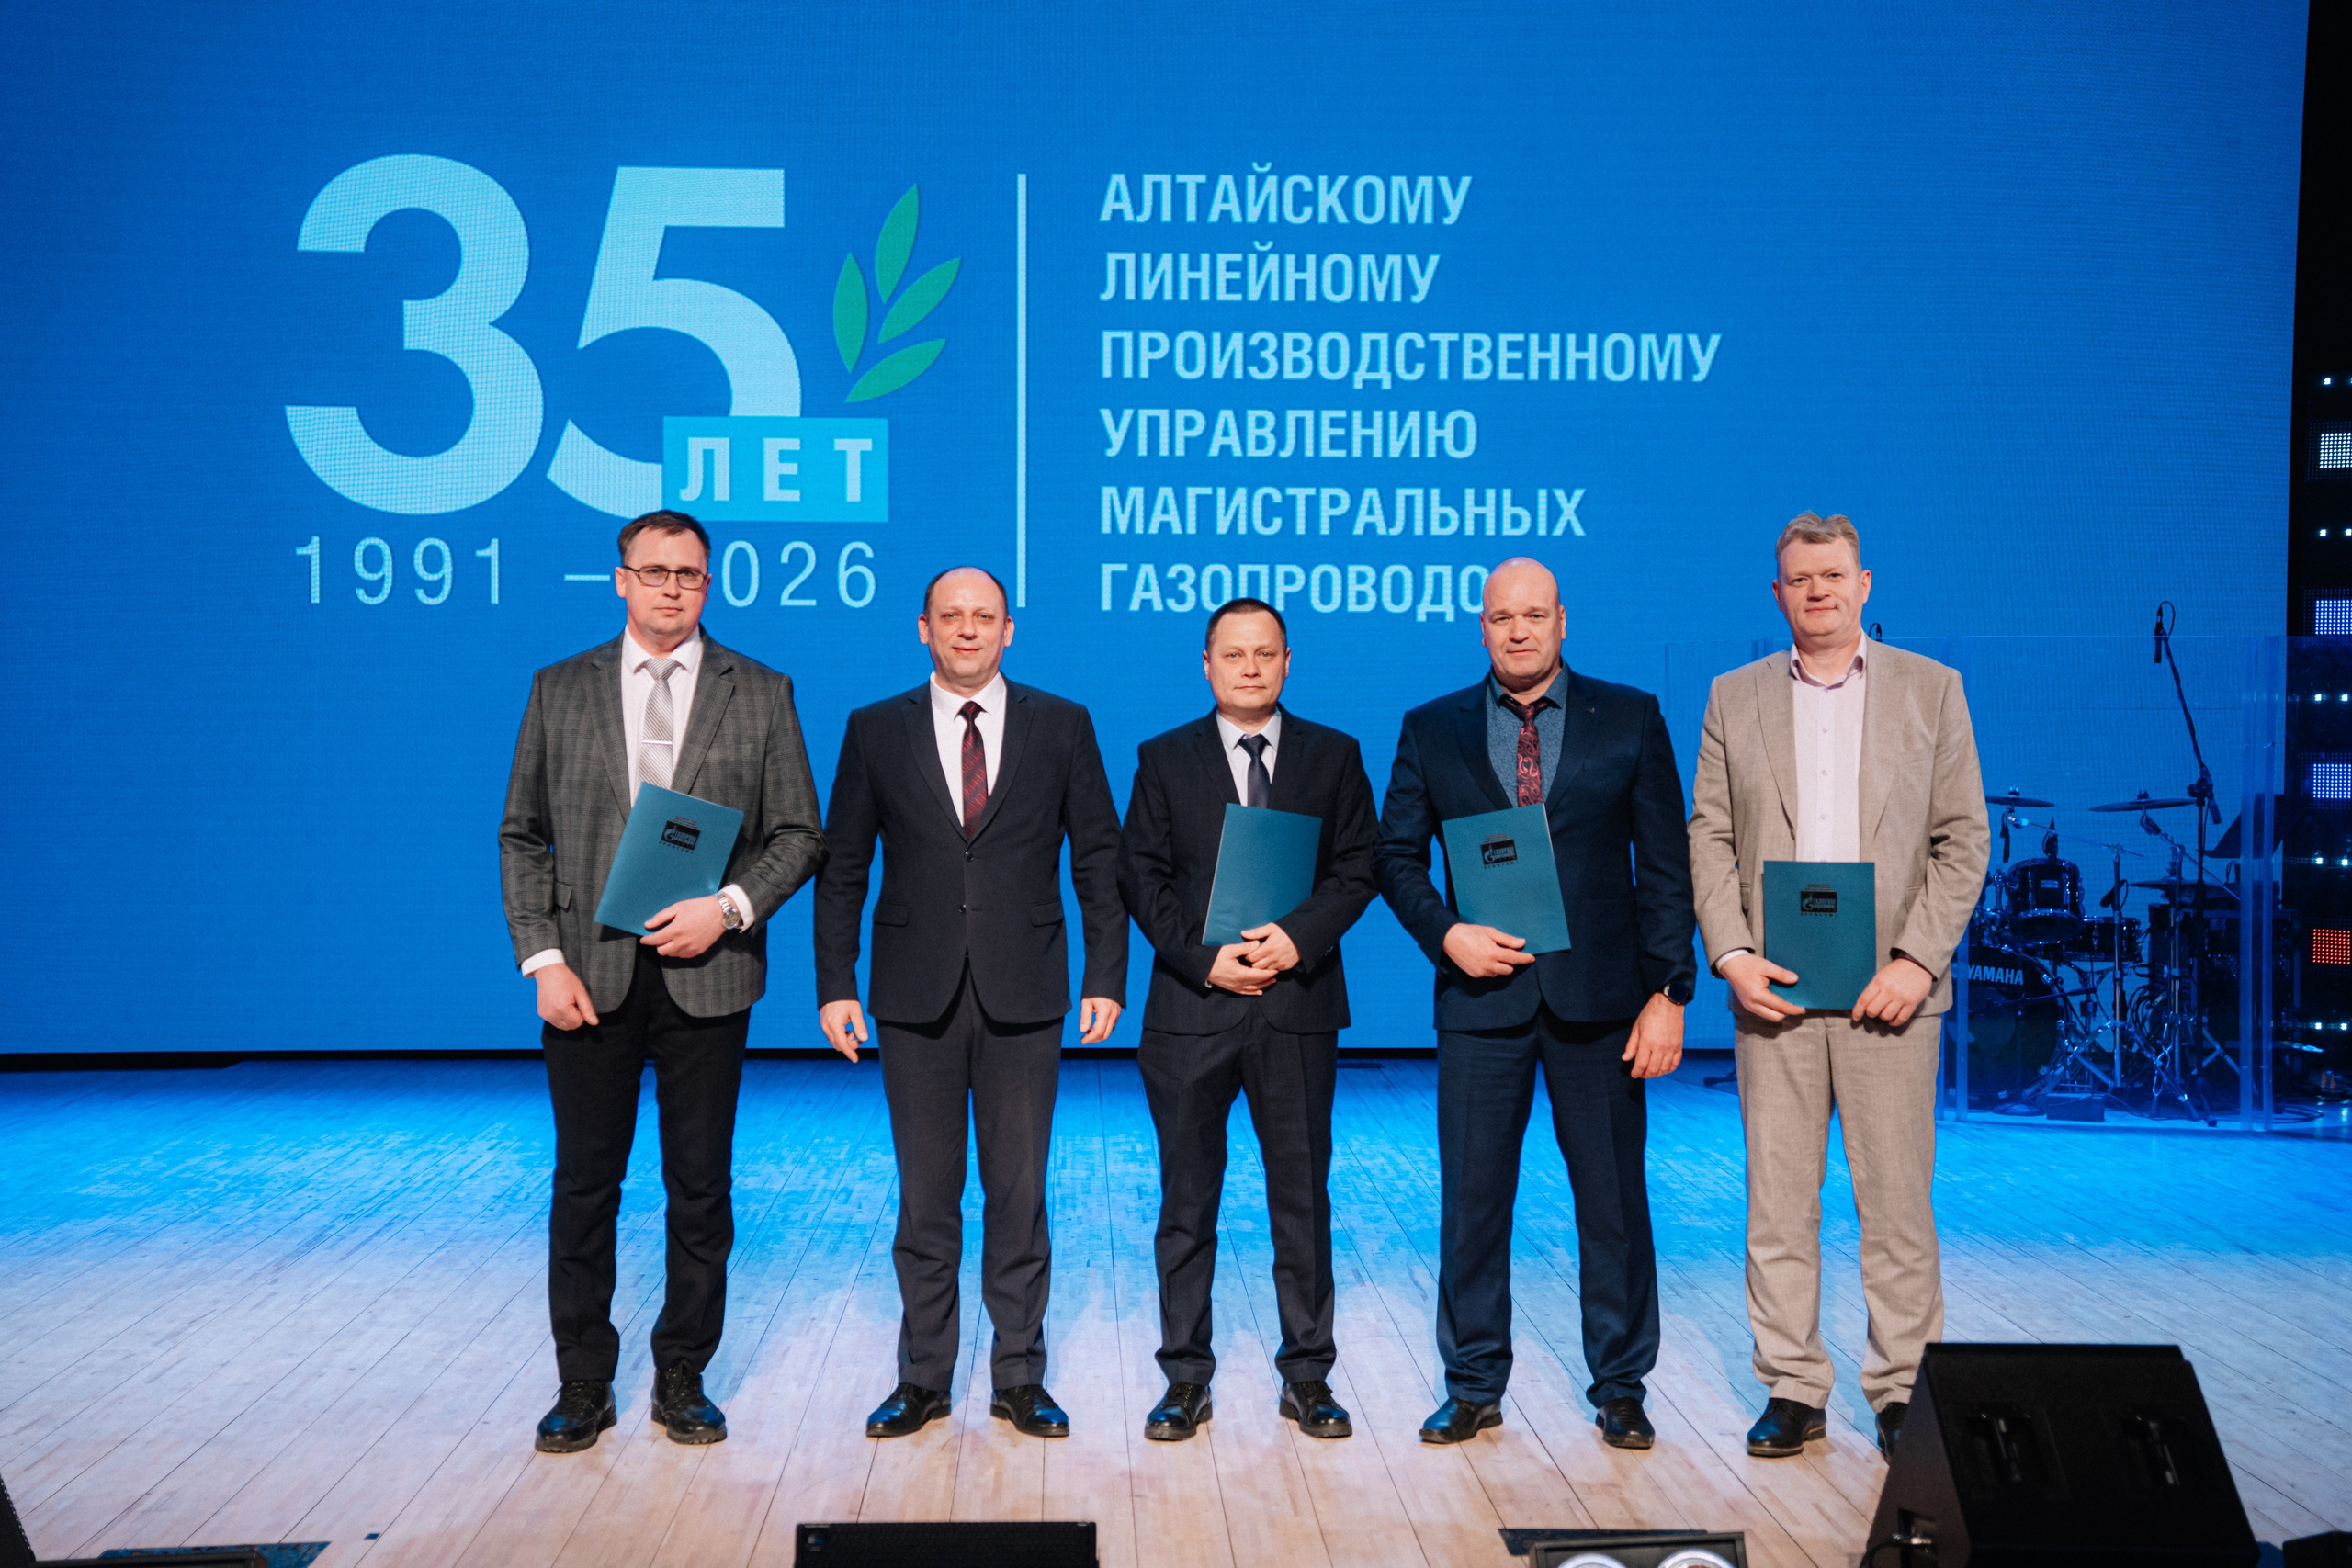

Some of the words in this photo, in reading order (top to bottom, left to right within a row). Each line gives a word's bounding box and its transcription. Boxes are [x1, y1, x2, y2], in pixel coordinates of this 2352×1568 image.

[1100, 162, 1472, 224] АЛТАЙСКОМУ
[1100, 240, 1441, 303] ЛИНЕЙНОМУ
[284, 153, 802, 519] 35
[1102, 330, 1722, 389] ПРОИЗВОДСТВЕННОМУ
[1100, 408, 1477, 458] УПРАВЛЕНИЮ
[679, 437, 873, 502] ЛЕТ
[1102, 486, 1587, 536] МАГИСТРАЛЬНЫХ
[295, 535, 501, 605] 1991
[721, 540, 877, 608] 026
[1102, 563, 1491, 622] ГАЗОПРОВОДО
[1966, 964, 2024, 985] YAMAHA
